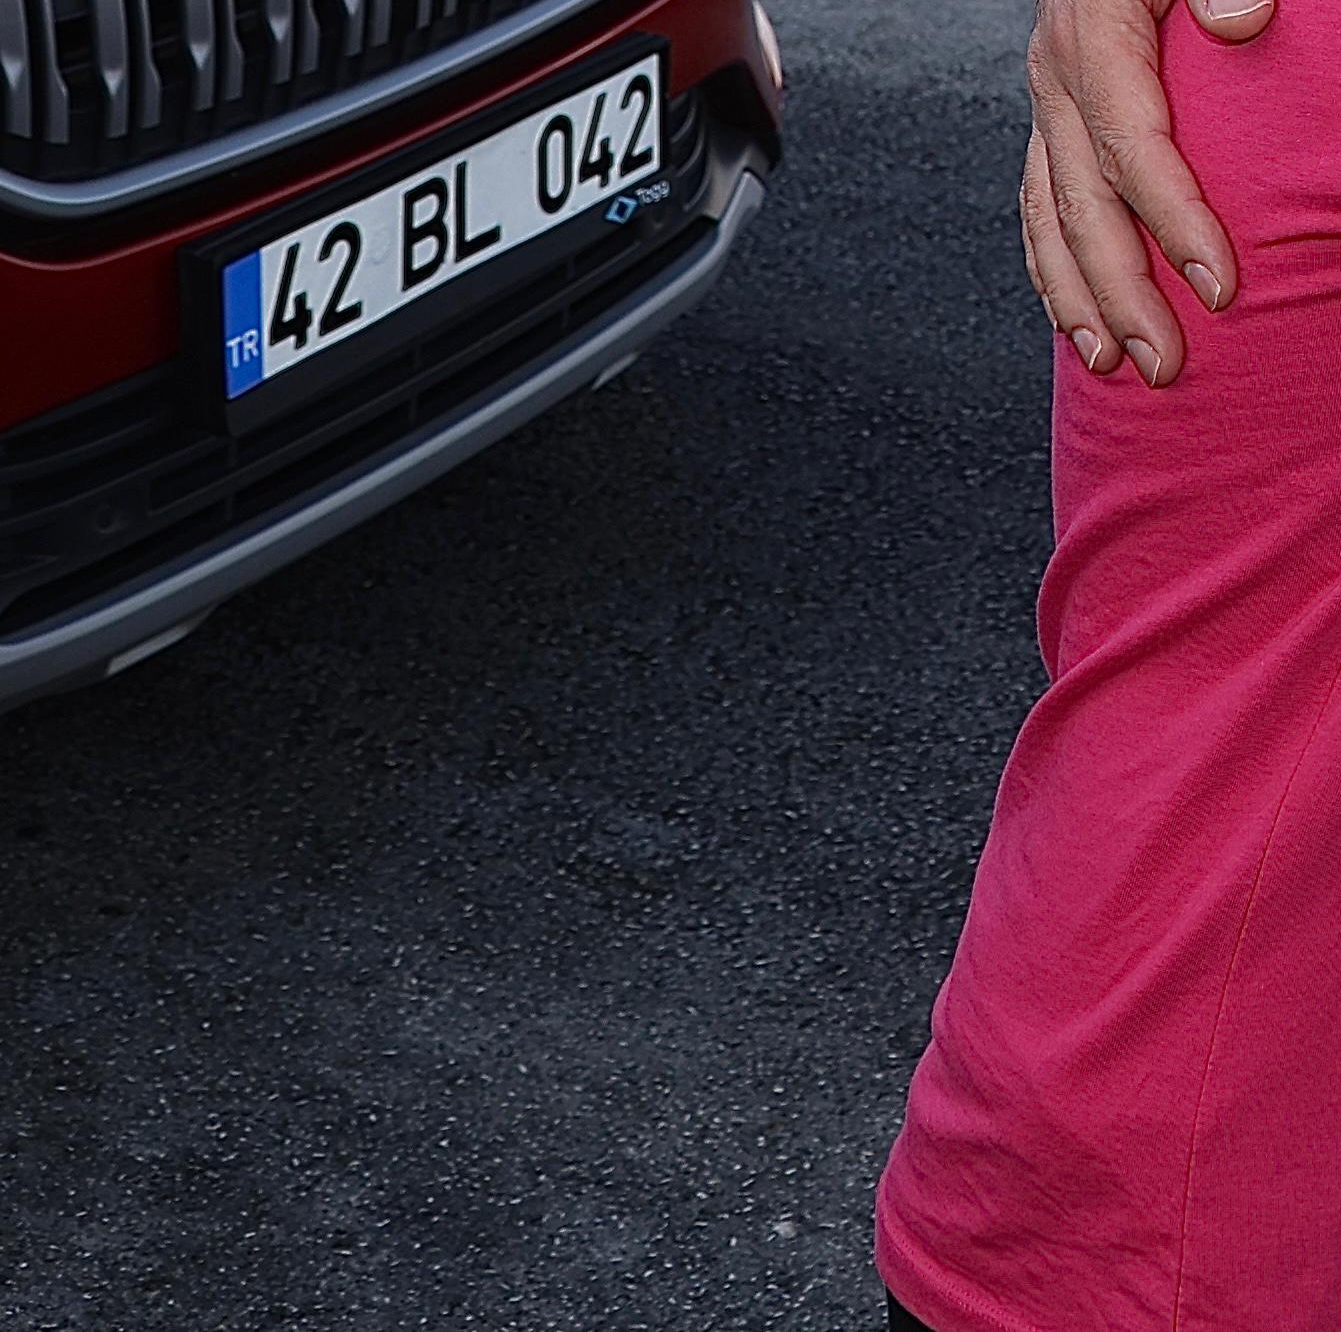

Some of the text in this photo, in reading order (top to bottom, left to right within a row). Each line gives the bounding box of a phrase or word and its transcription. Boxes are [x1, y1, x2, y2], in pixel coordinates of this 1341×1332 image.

[269, 74, 653, 349] 42 BL 042
[226, 331, 259, 370] TR
